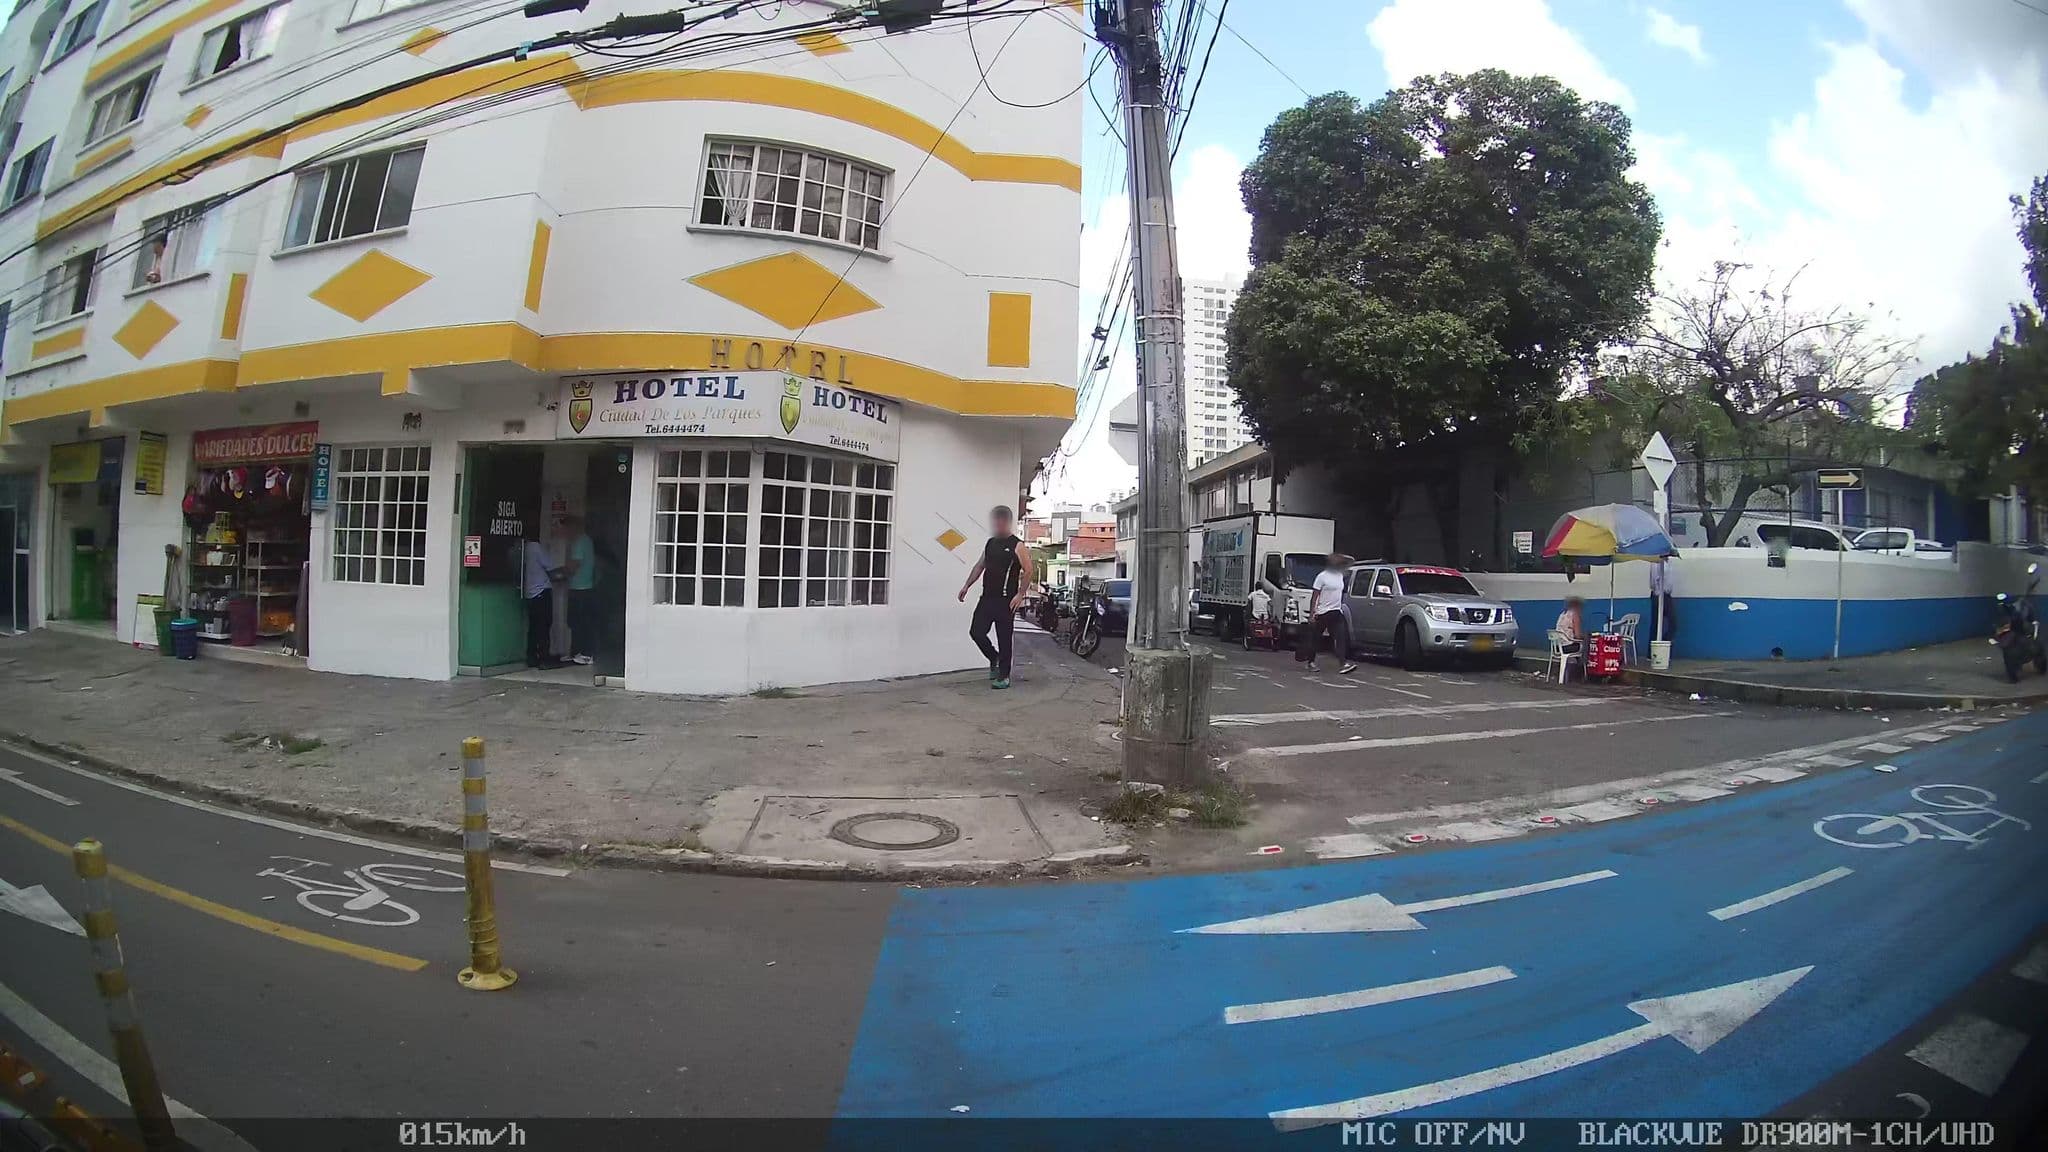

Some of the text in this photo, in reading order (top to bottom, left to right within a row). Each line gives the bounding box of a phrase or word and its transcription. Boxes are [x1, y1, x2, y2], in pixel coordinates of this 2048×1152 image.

[709, 338, 854, 385] HOTEL
[613, 376, 745, 404] HOTEL
[599, 405, 762, 424] Ciudad De Los Parques
[812, 386, 888, 424] HOTEL
[316, 445, 329, 498] HOTEL
[497, 500, 516, 517] SIGA
[489, 518, 523, 537] ABIERTO
